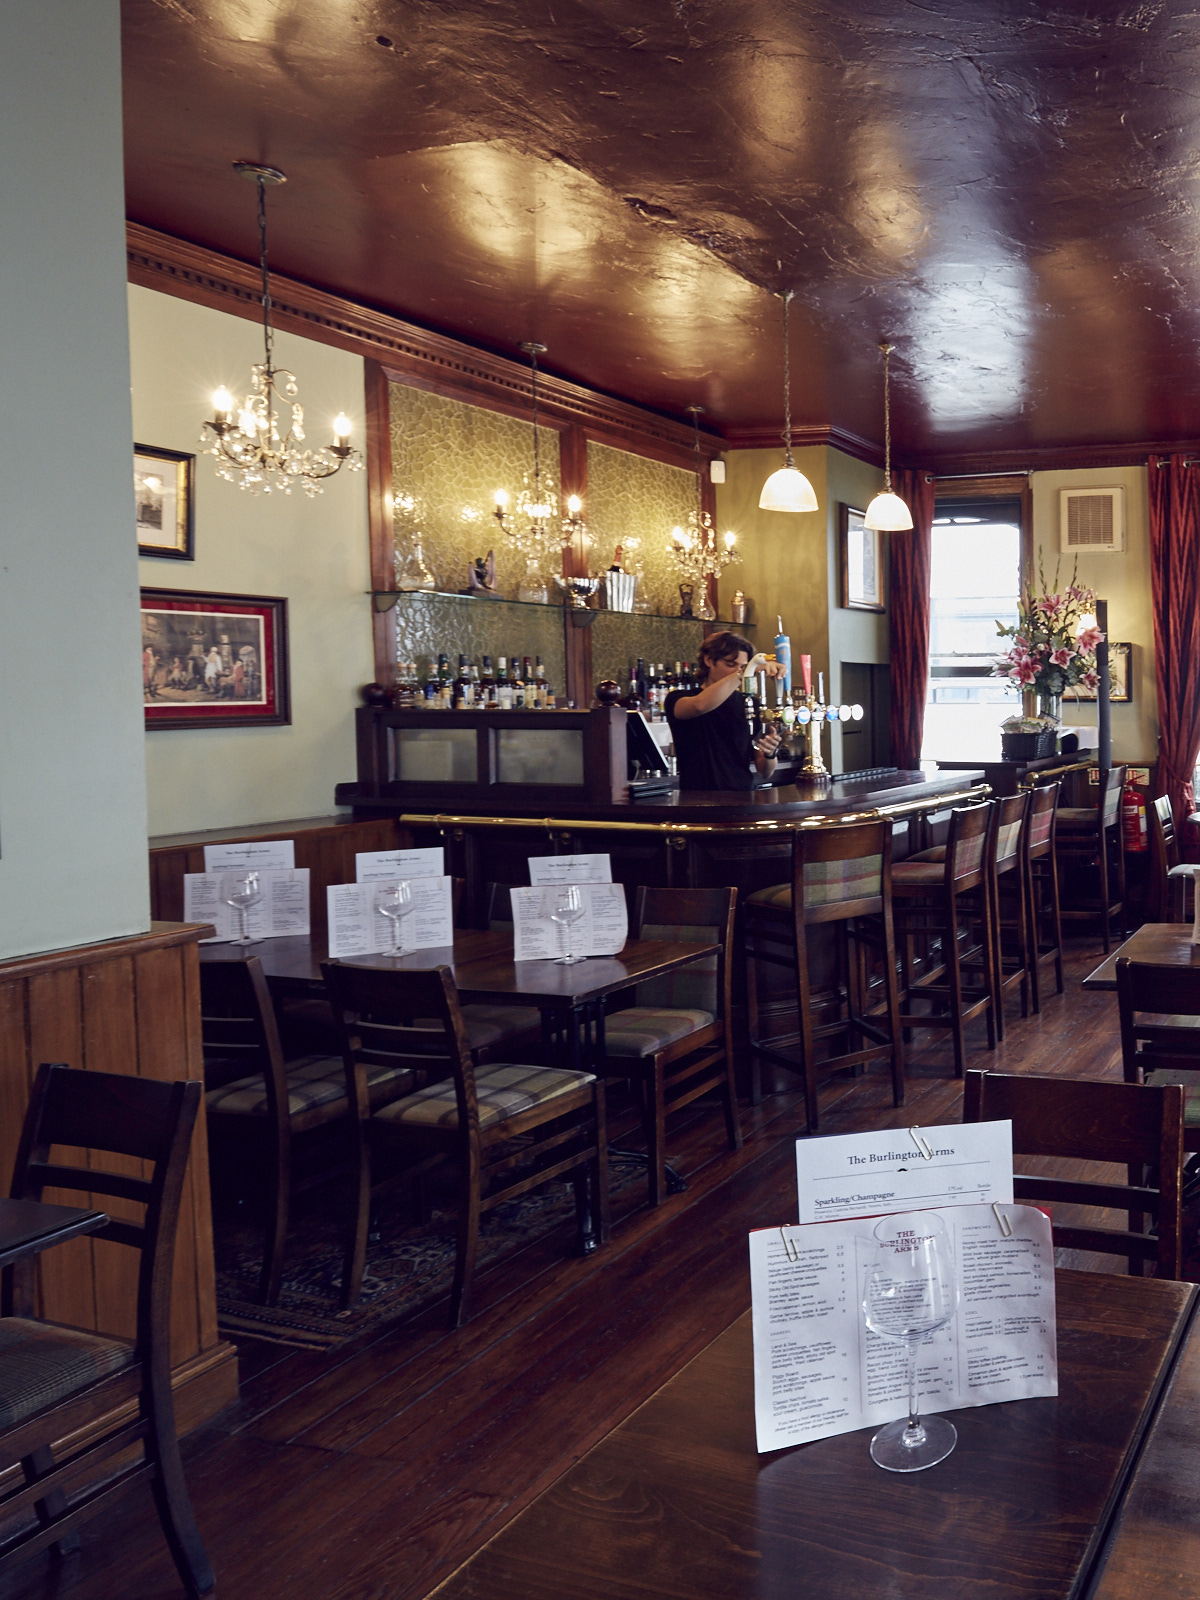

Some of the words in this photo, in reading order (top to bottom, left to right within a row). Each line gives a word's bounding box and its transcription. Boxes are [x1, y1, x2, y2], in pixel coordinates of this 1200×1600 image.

[847, 1156, 867, 1165] The
[869, 1151, 925, 1162] Burlington
[814, 1190, 895, 1207] Sparkling/Champagne
[896, 1230, 915, 1238] THE
